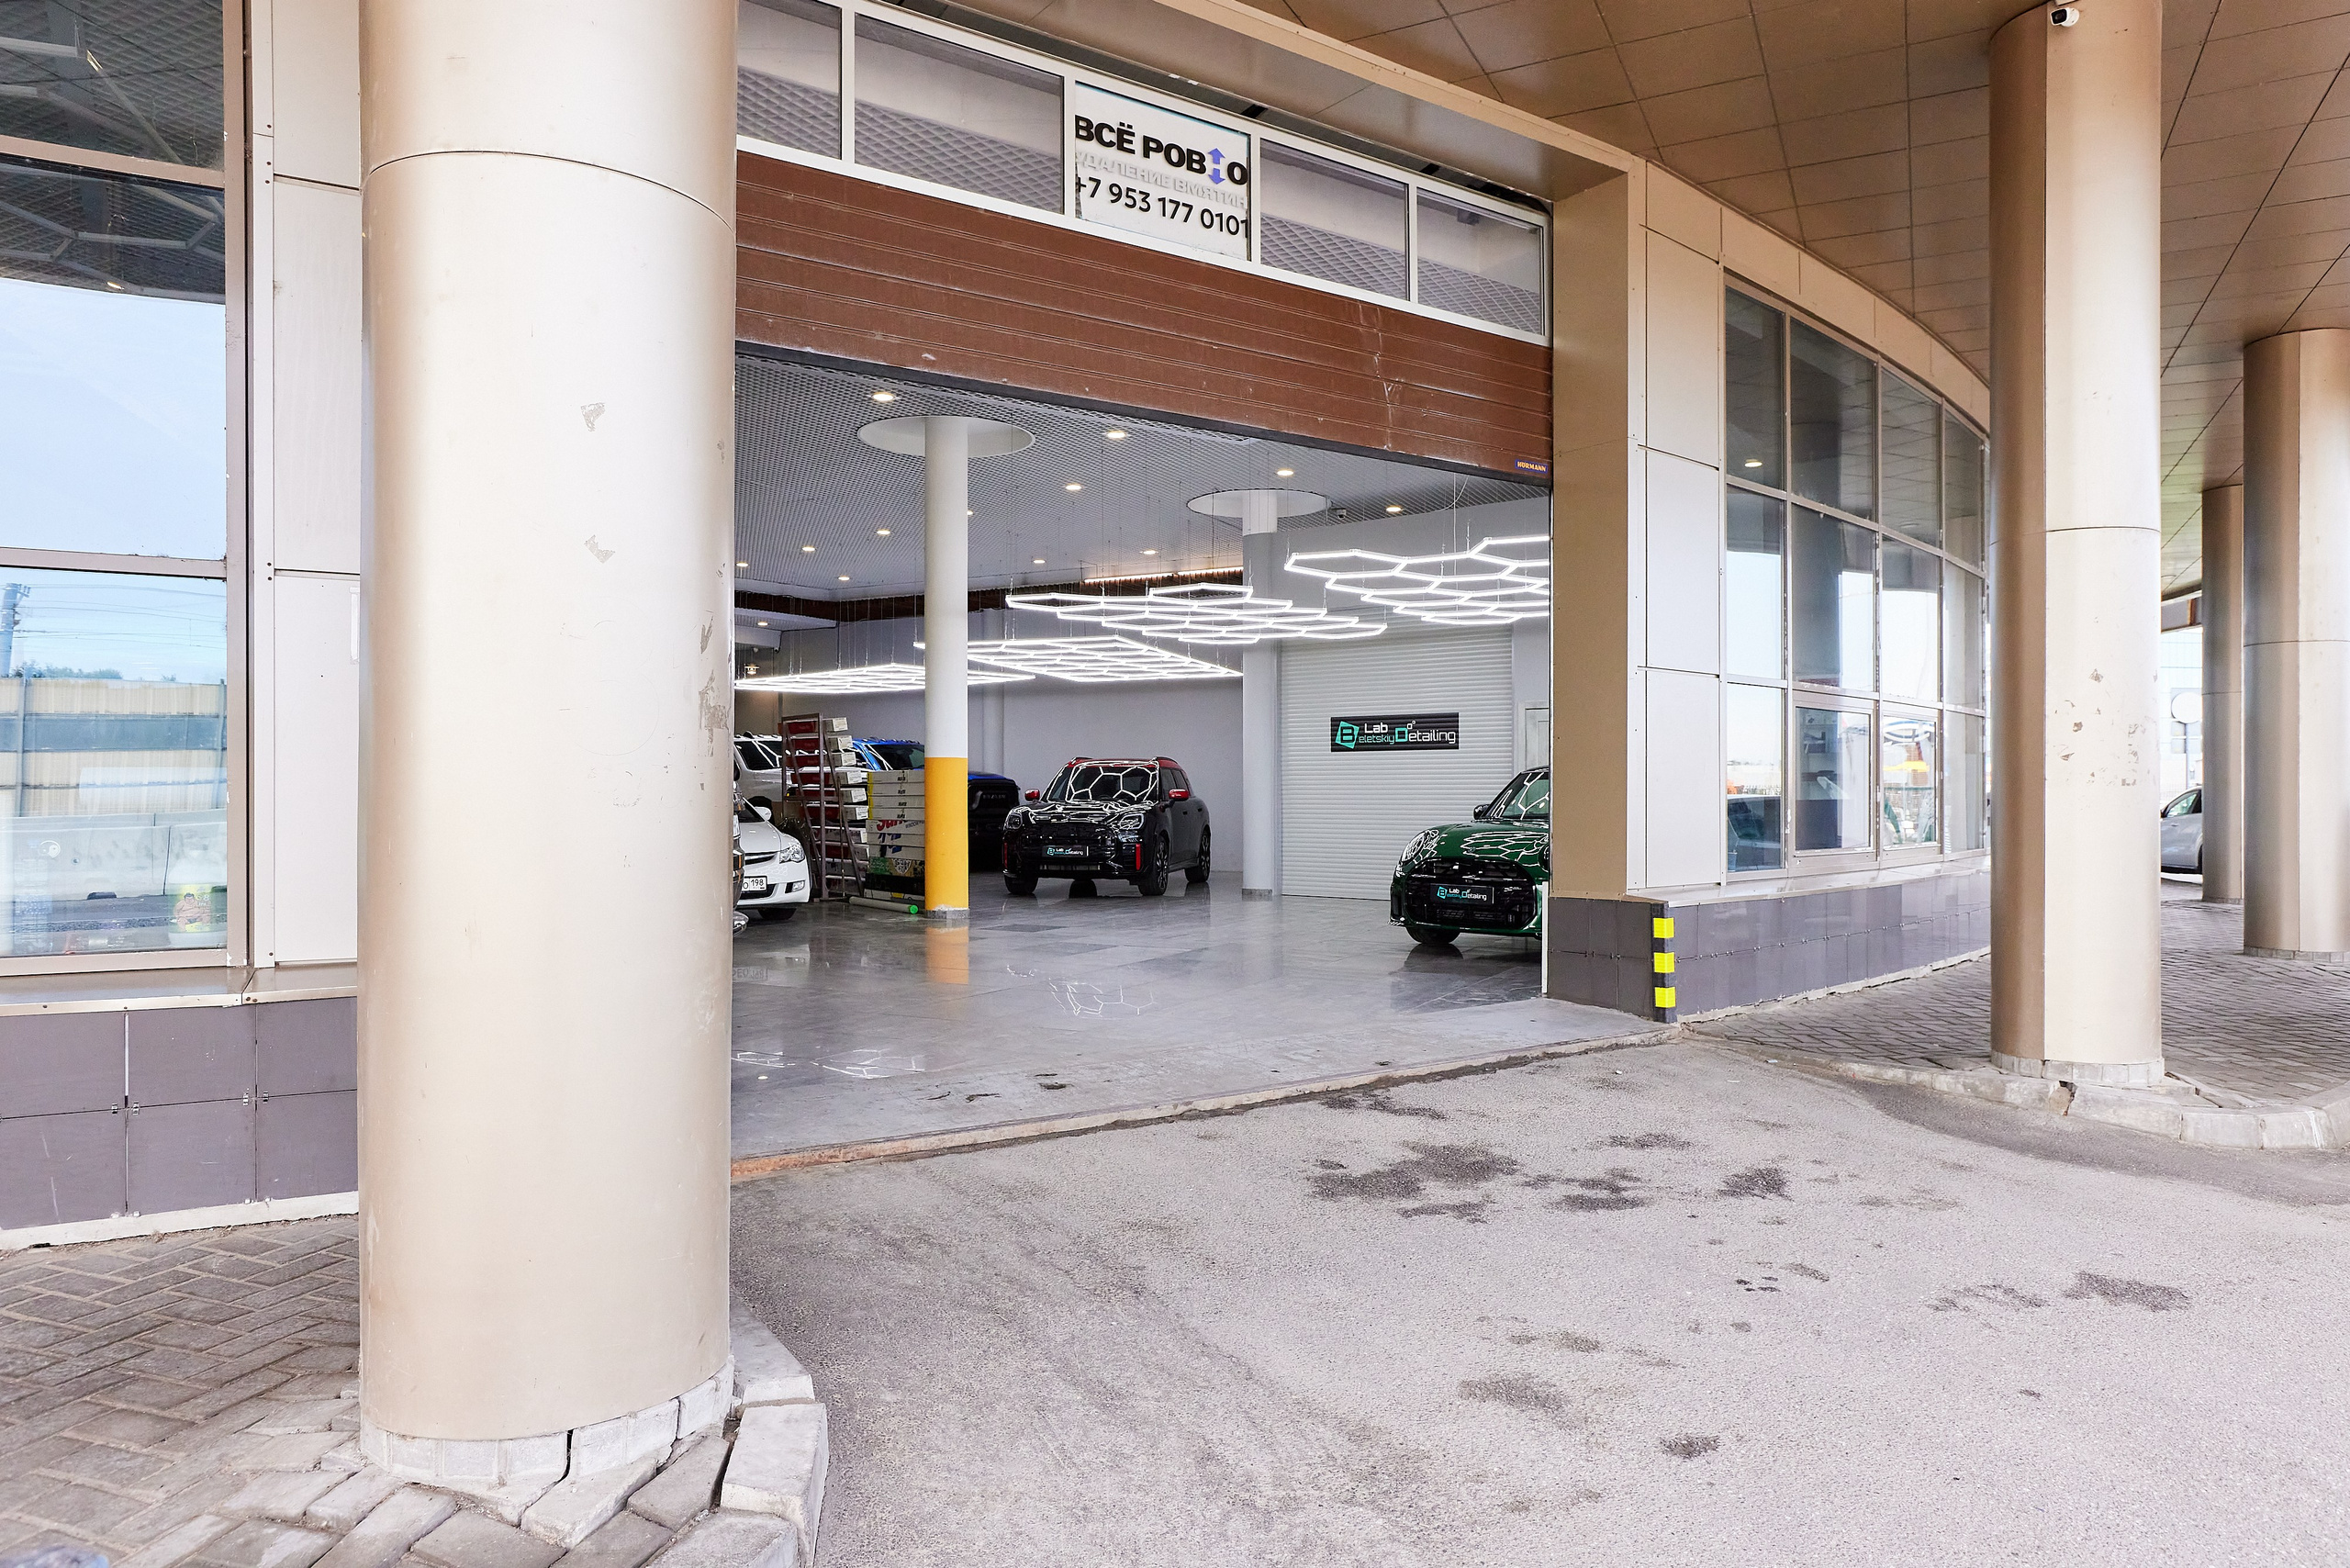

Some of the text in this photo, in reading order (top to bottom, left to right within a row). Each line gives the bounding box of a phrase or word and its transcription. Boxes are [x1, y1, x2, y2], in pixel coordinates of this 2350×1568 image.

[1075, 114, 1136, 155] ВСЁ
[1109, 183, 1152, 213] 953
[1158, 196, 1194, 223] 177
[1200, 207, 1248, 239] 0101
[1364, 722, 1389, 734] Lab
[1395, 727, 1456, 745] Detailing
[750, 879, 765, 887] 198
